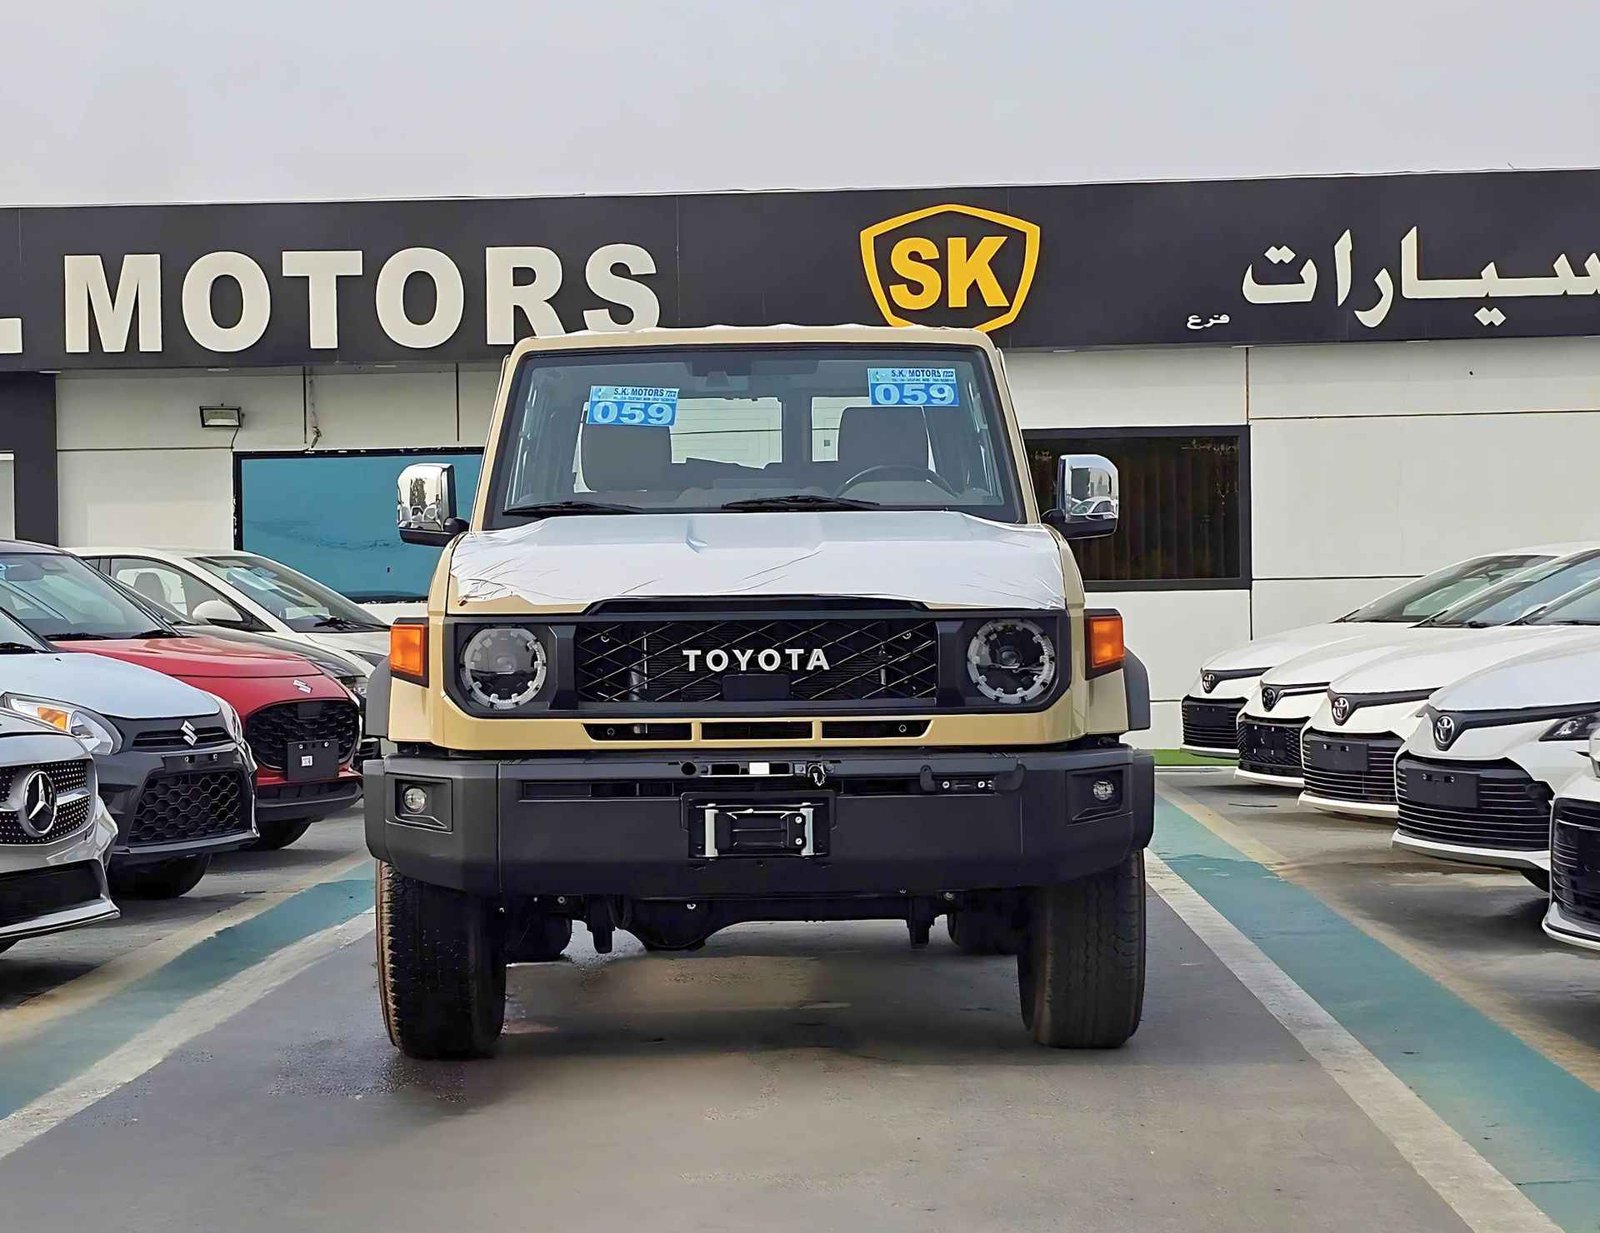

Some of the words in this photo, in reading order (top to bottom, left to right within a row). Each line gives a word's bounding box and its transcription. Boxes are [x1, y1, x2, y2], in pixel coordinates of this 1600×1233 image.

[888, 237, 1010, 310] SK
[64, 243, 660, 353] MOTORS
[1187, 314, 1230, 330] فرع
[908, 369, 942, 378] MOTORS
[631, 387, 665, 397] MOTORS
[874, 383, 955, 405] 059
[593, 401, 673, 425] 059
[682, 648, 830, 672] TOYOTA
